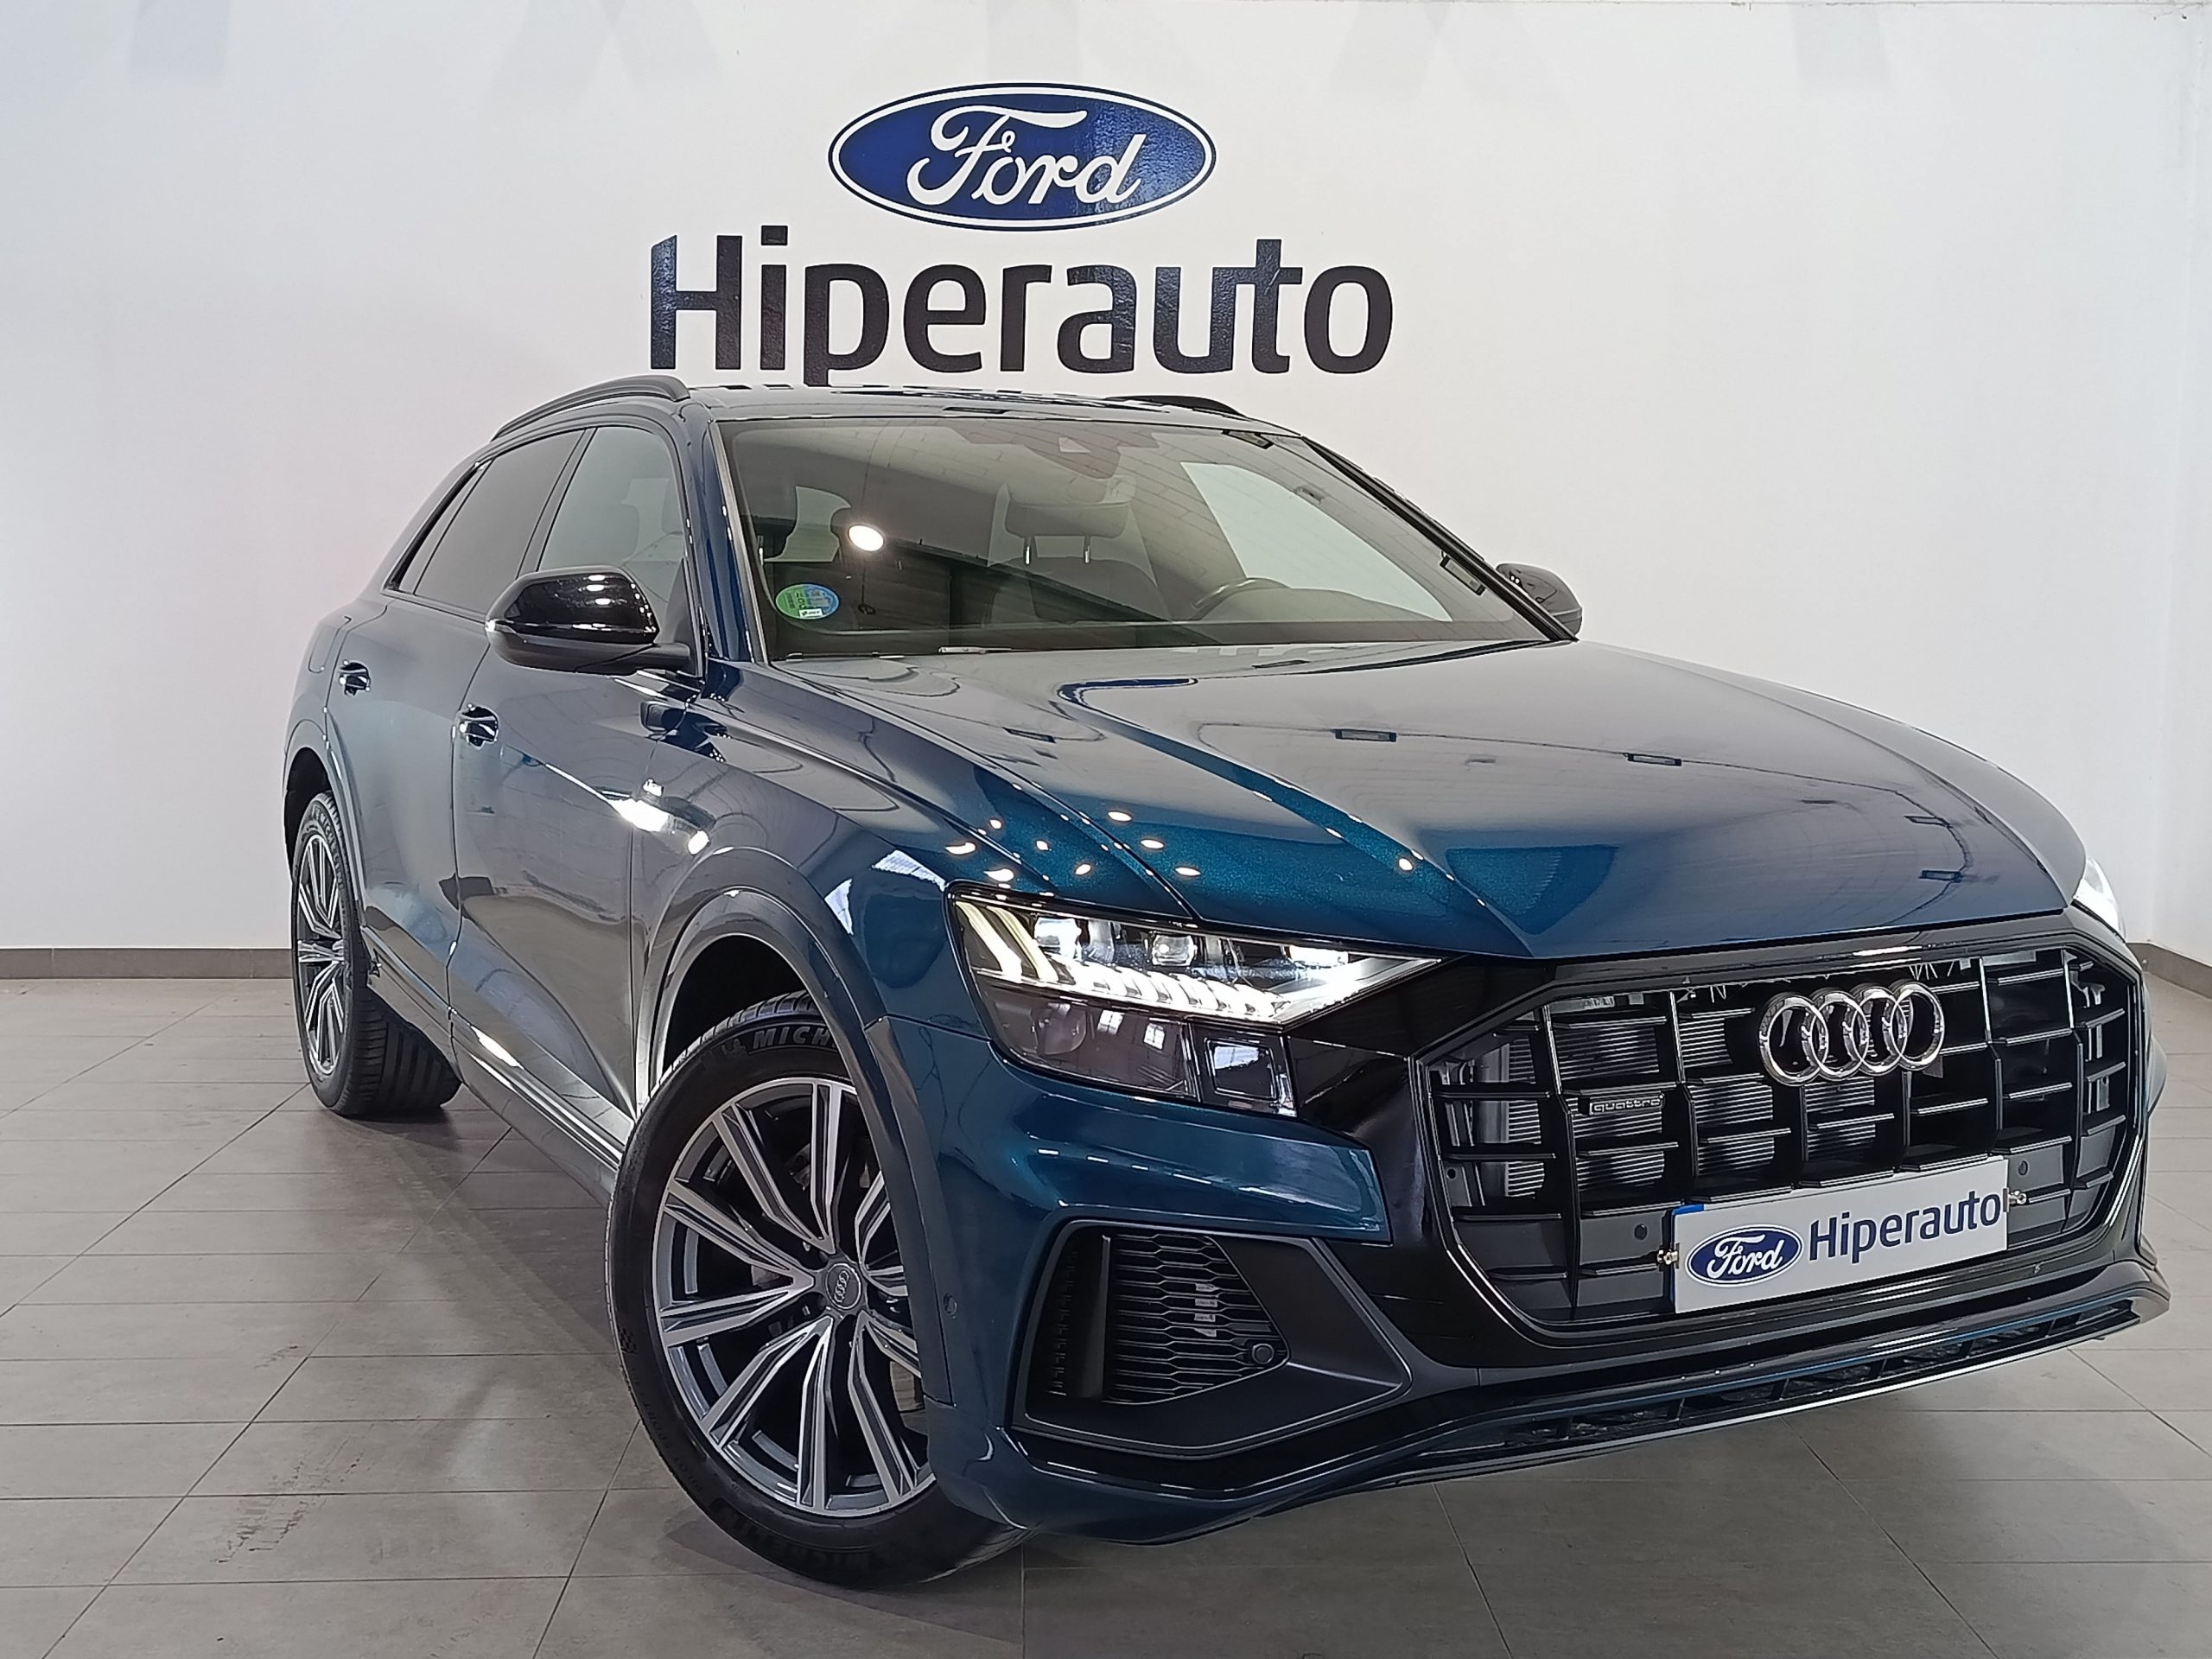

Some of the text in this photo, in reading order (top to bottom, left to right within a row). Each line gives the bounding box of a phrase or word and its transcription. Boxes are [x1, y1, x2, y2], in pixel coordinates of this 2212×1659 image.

[906, 105, 1147, 205] Ford
[650, 225, 1394, 387] Hiperauto
[753, 1025, 836, 1049] MICH
[1593, 1098, 1661, 1113] quattro
[1706, 1191, 2002, 1278] Ford Hiperauto
